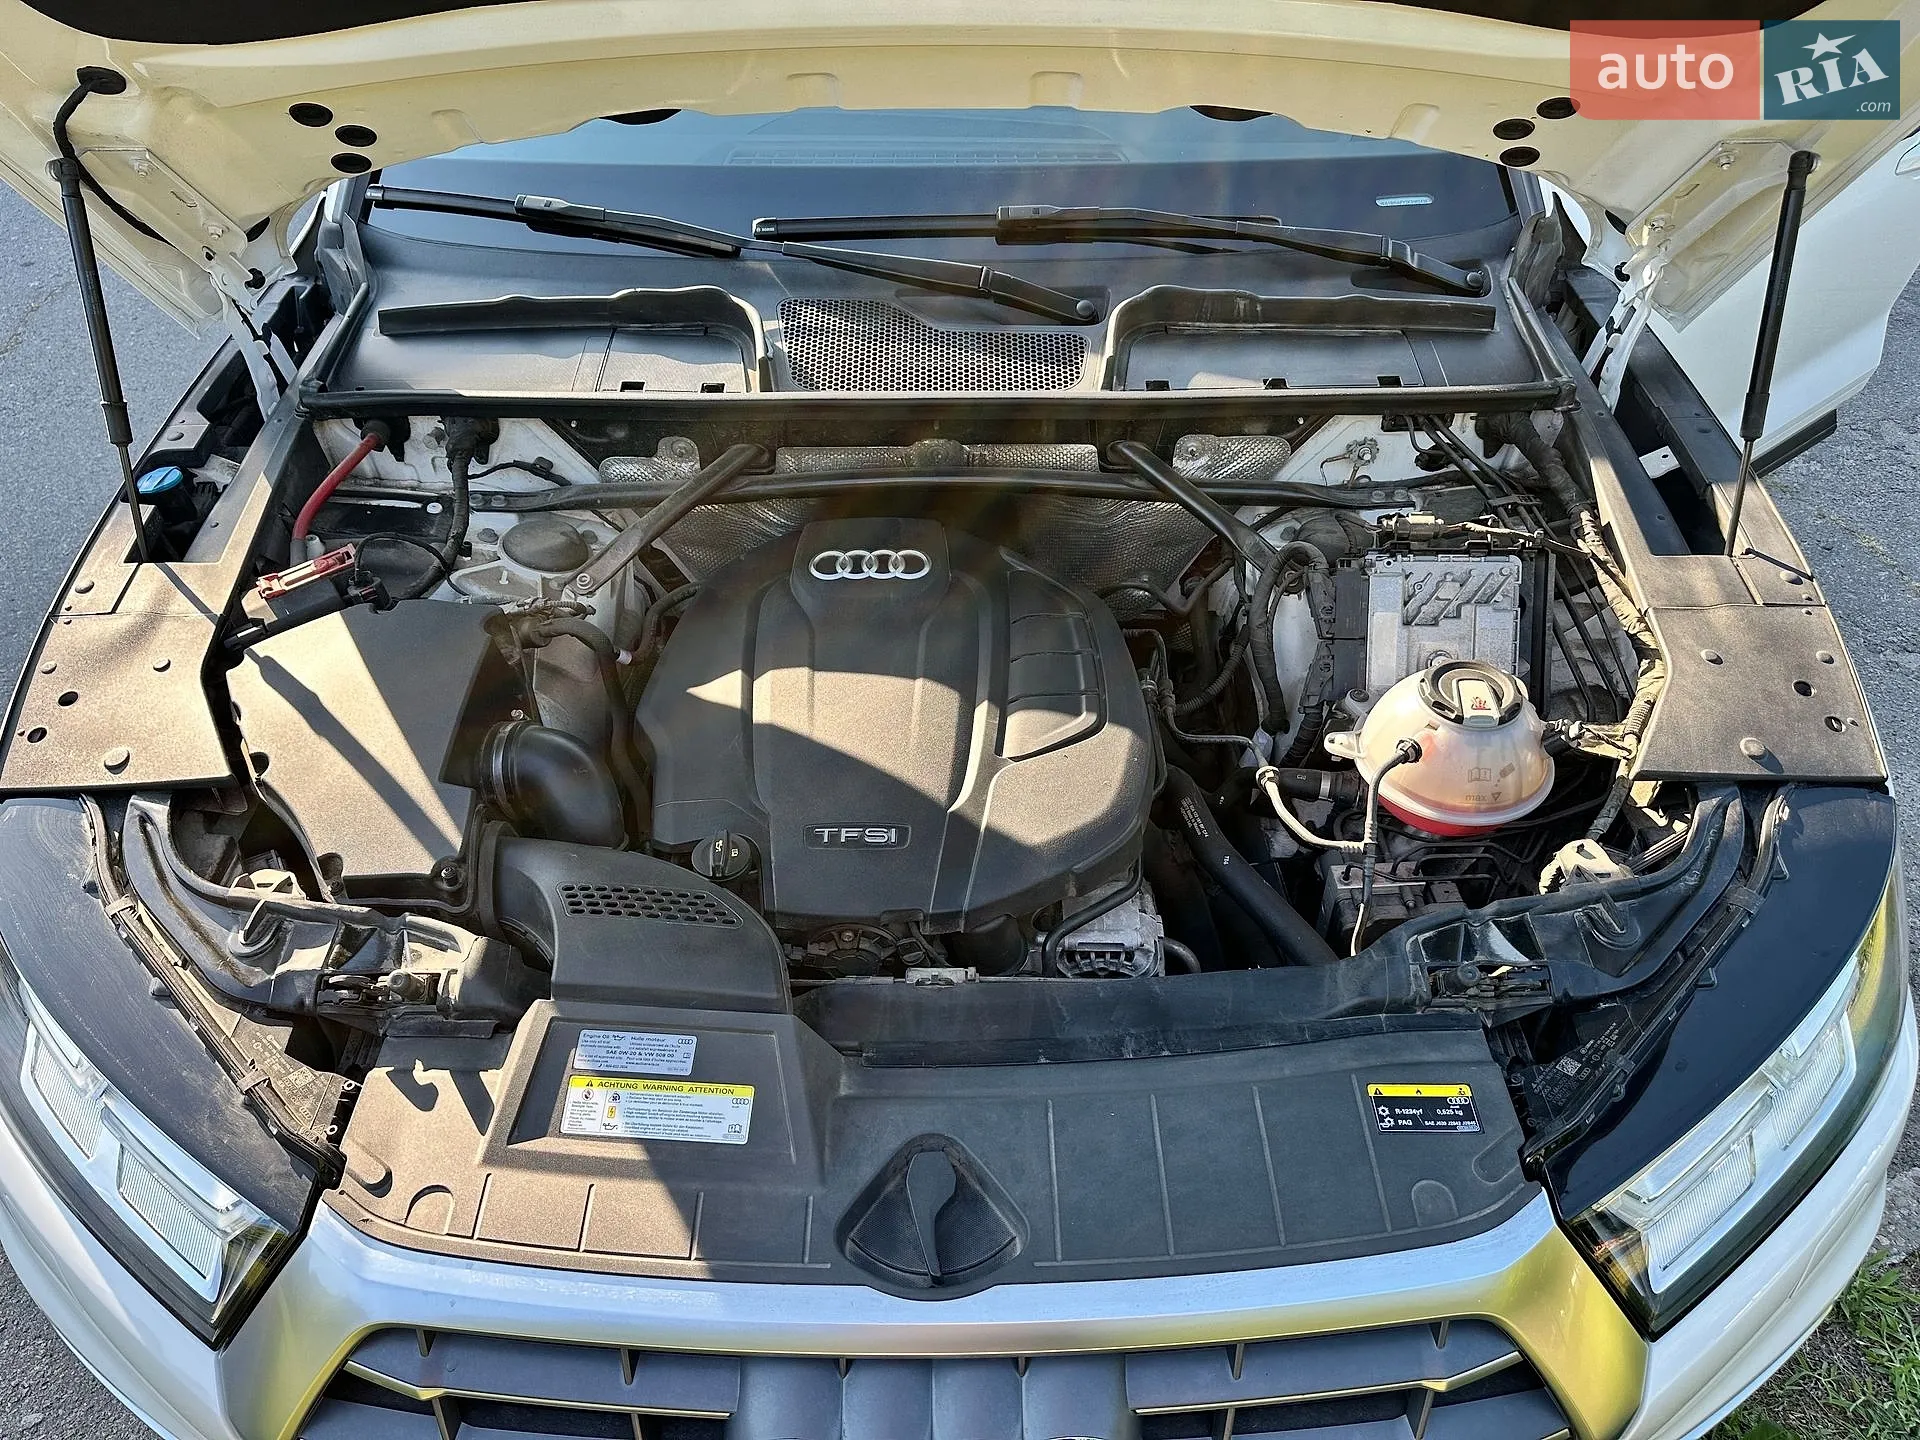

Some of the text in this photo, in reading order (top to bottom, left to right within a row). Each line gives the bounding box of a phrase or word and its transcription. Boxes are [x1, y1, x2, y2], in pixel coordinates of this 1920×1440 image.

[814, 827, 896, 843] TFSI
[597, 1081, 734, 1095] ACHTUNG WARNING ATTENTION
[1395, 1108, 1422, 1116] R-1234yf
